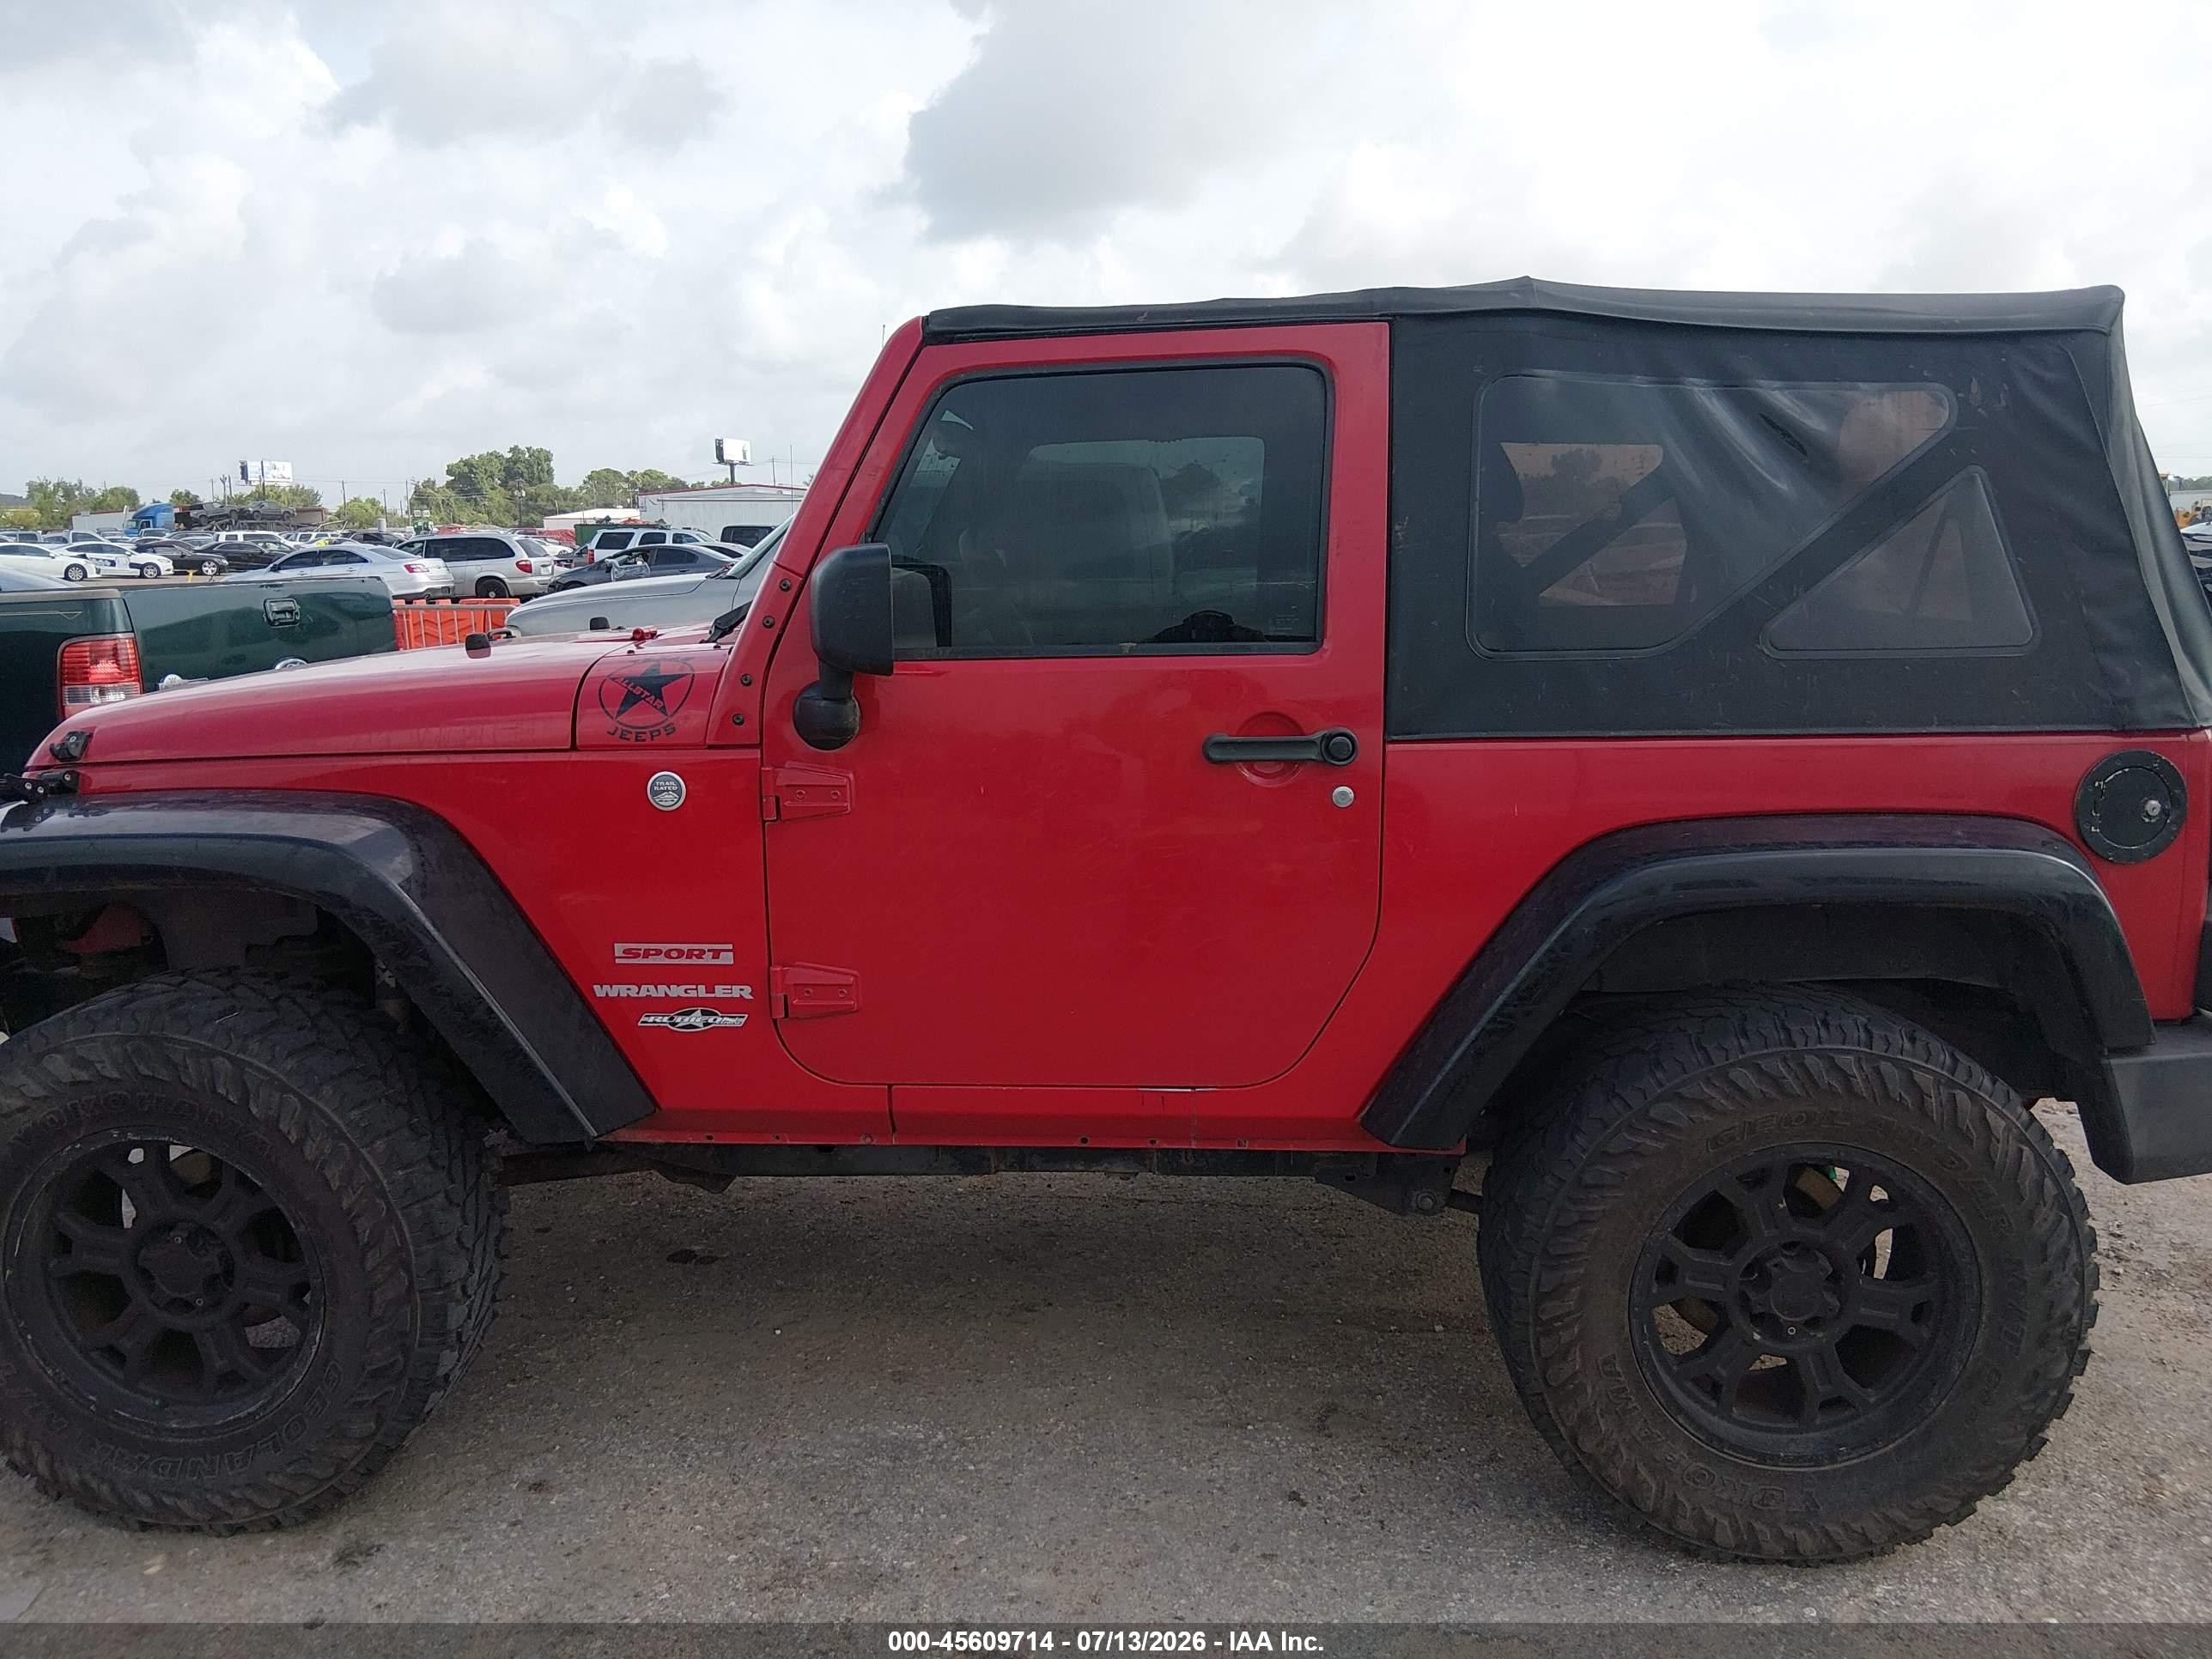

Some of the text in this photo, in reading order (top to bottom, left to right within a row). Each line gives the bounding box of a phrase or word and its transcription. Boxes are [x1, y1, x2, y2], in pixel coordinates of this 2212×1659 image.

[607, 723, 677, 743] JEEPS
[617, 946, 733, 961] SPORT
[592, 984, 755, 1000] WRANGLER
